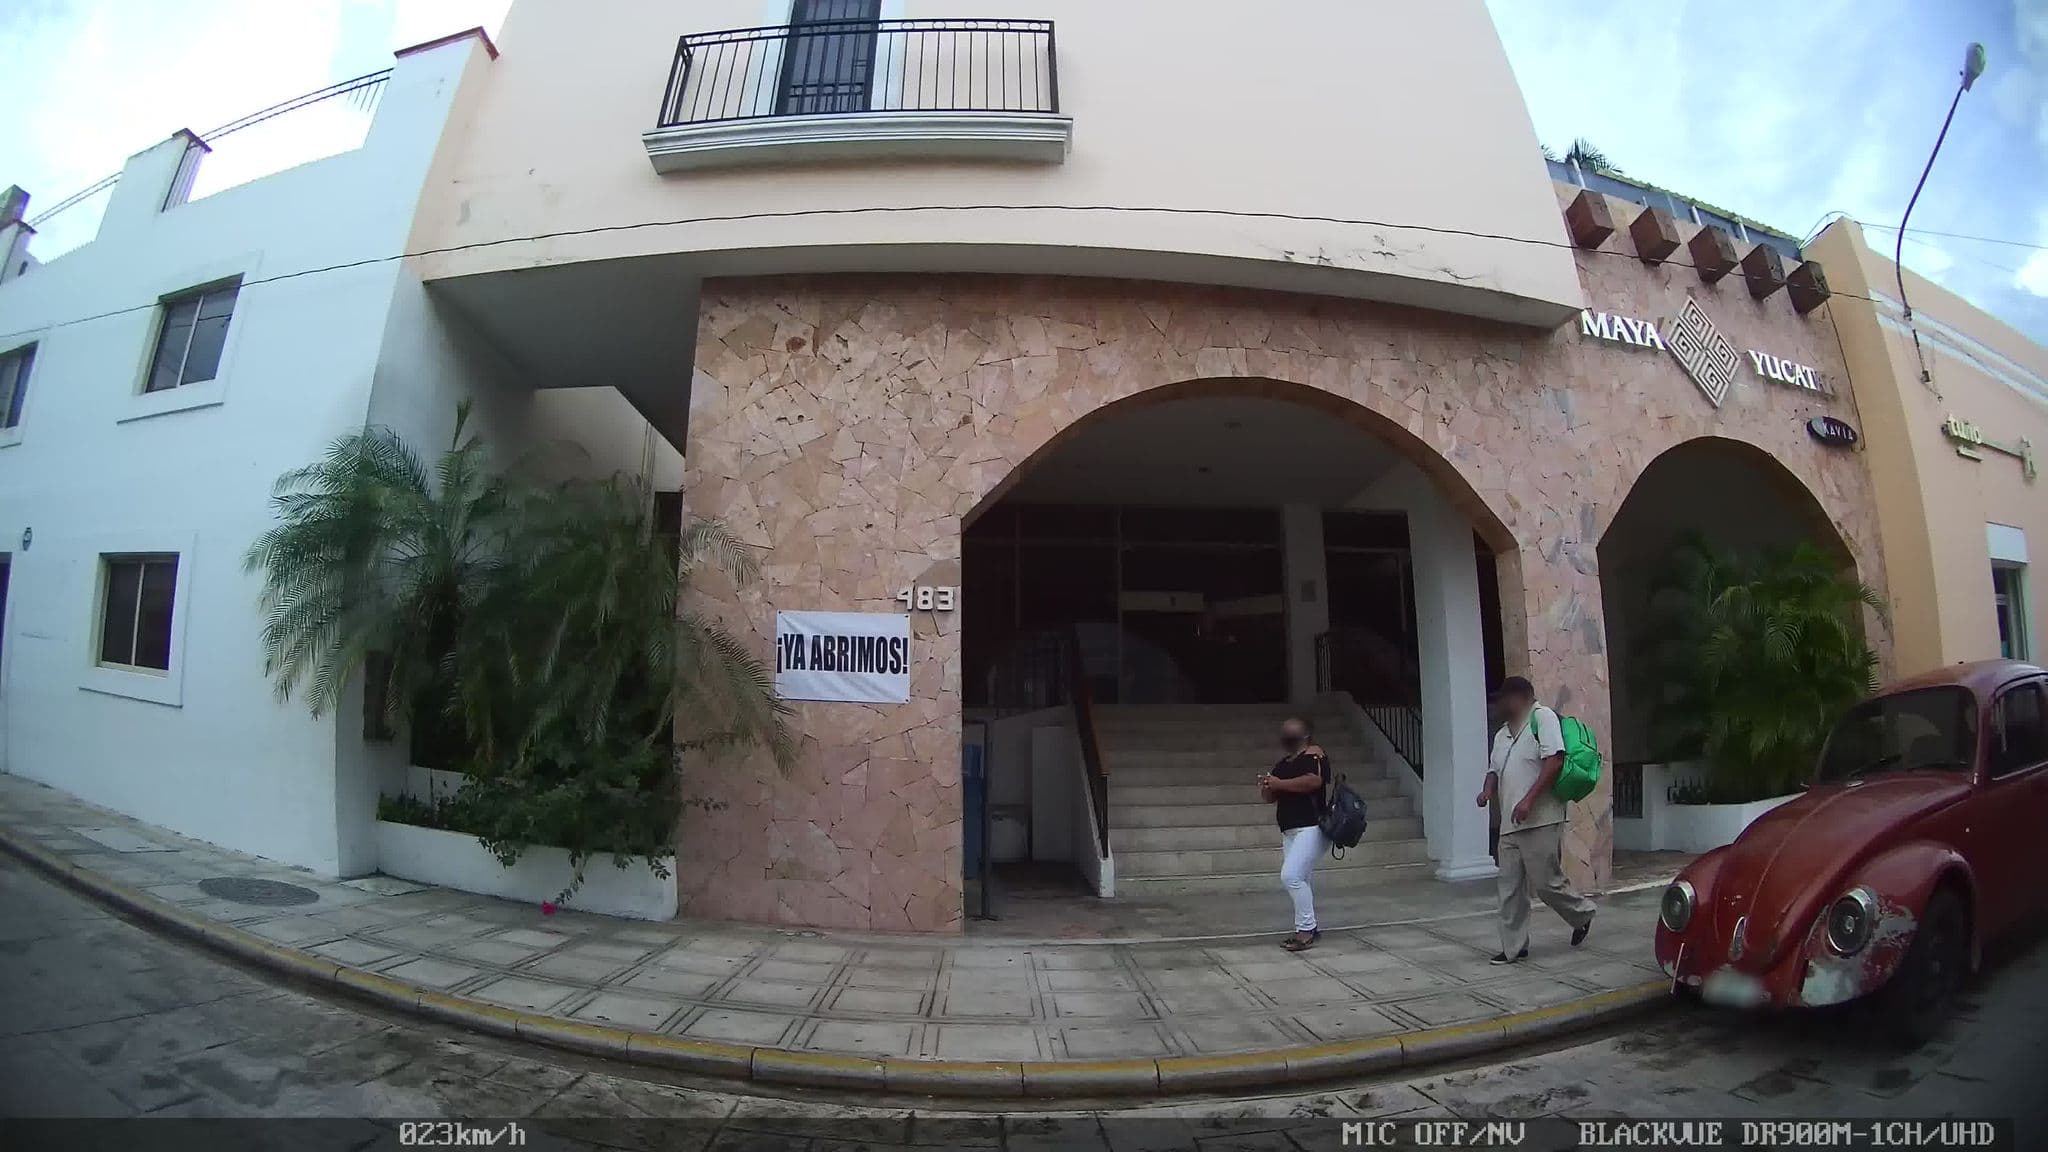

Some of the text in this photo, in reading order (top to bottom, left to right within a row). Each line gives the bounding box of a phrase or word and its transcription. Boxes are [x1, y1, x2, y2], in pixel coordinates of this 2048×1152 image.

[1581, 309, 1666, 350] MAYA
[896, 585, 953, 610] 483
[777, 633, 908, 674] ¡YA ABRIMOS!
